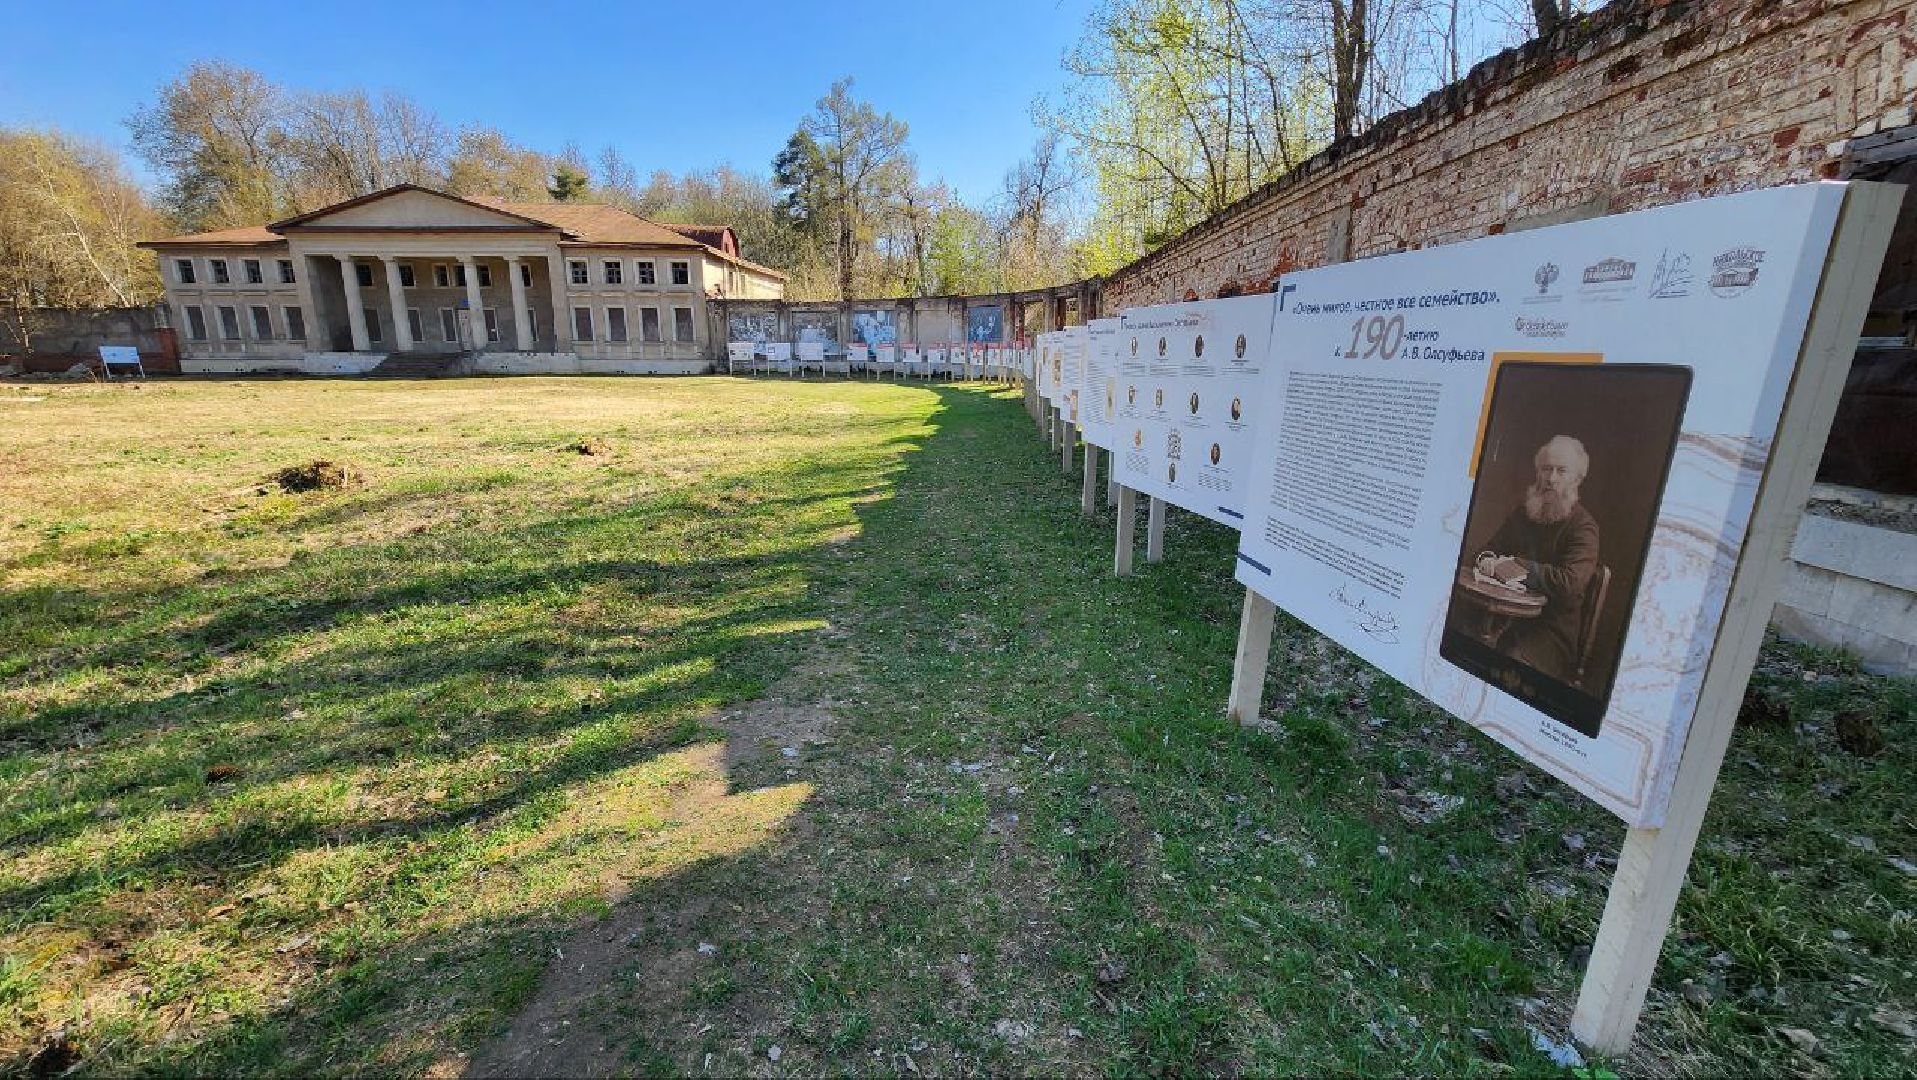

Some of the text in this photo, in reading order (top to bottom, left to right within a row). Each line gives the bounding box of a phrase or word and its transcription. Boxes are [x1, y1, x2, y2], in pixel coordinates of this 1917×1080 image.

[1355, 298, 1394, 311] честное
[1397, 296, 1416, 309] все
[1418, 288, 1500, 308] семейство».
[1423, 346, 1486, 363] Олсуфьева
